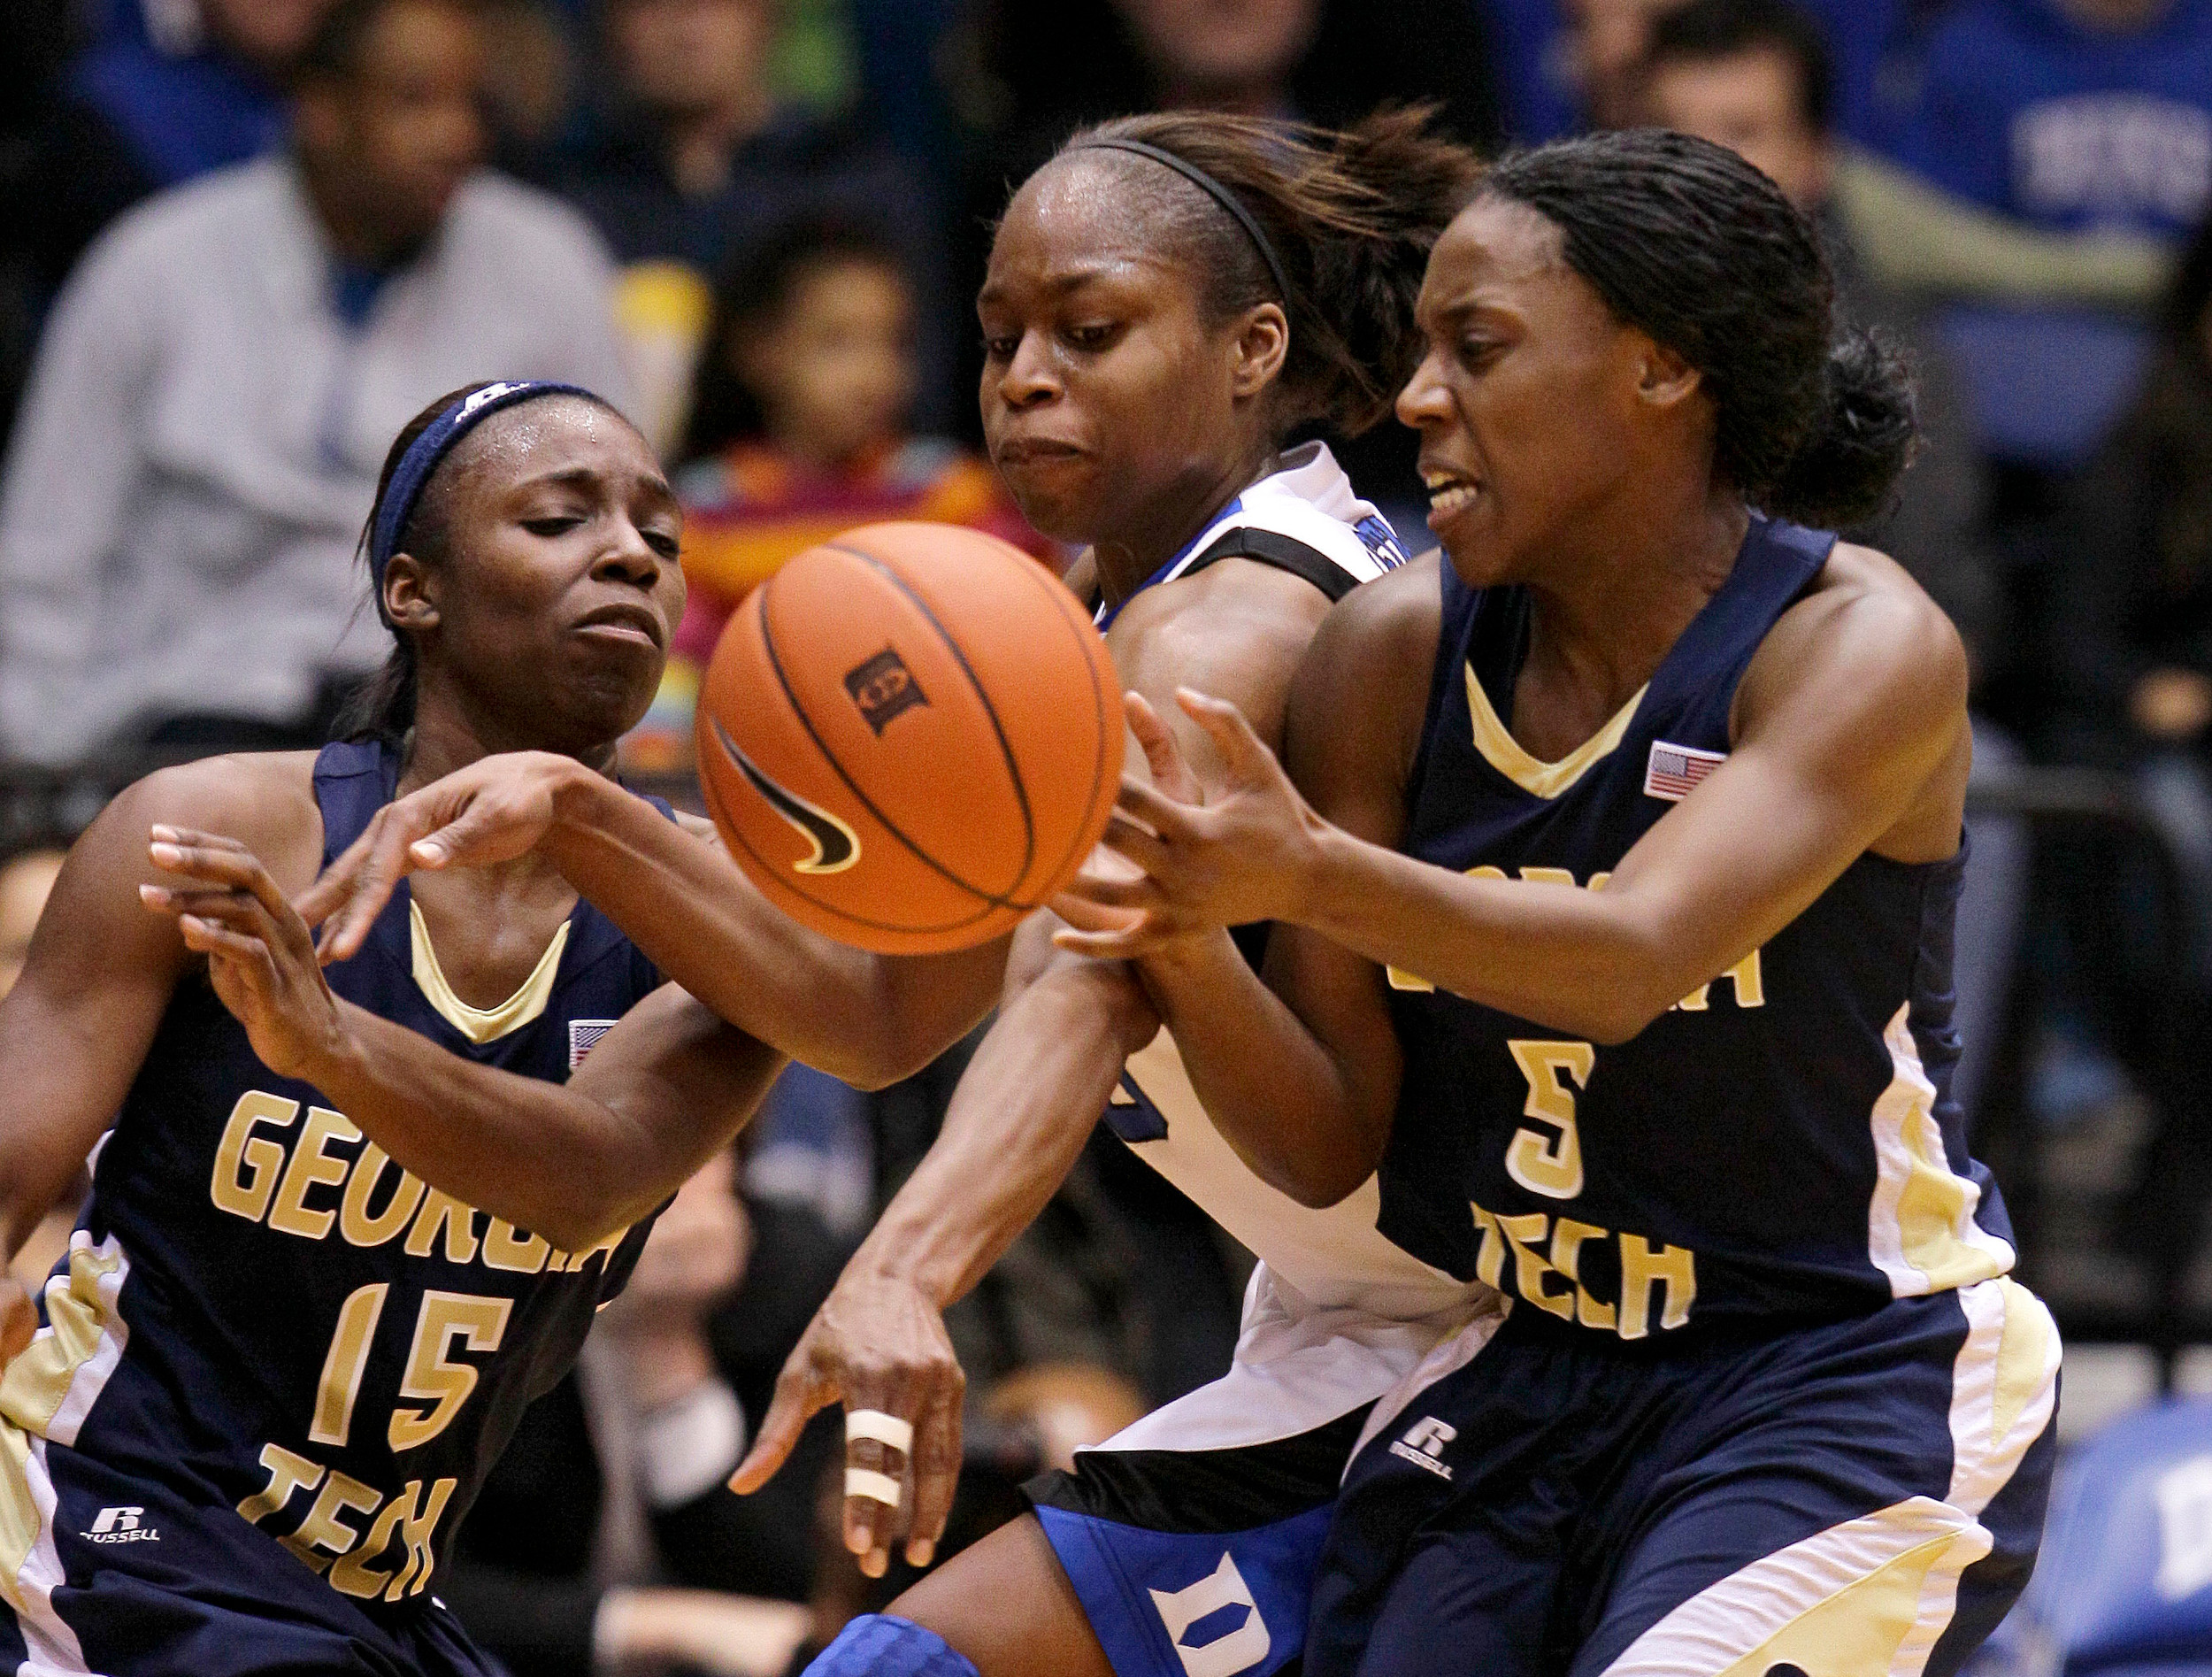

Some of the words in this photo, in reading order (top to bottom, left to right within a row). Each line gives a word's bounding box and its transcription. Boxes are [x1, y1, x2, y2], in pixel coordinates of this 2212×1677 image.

[210, 1089, 630, 1274] GEOR
[1505, 1039, 1596, 1200] 5
[1469, 1200, 1697, 1341] TECH
[307, 1282, 514, 1453] 15
[235, 1442, 458, 1603] TECH
